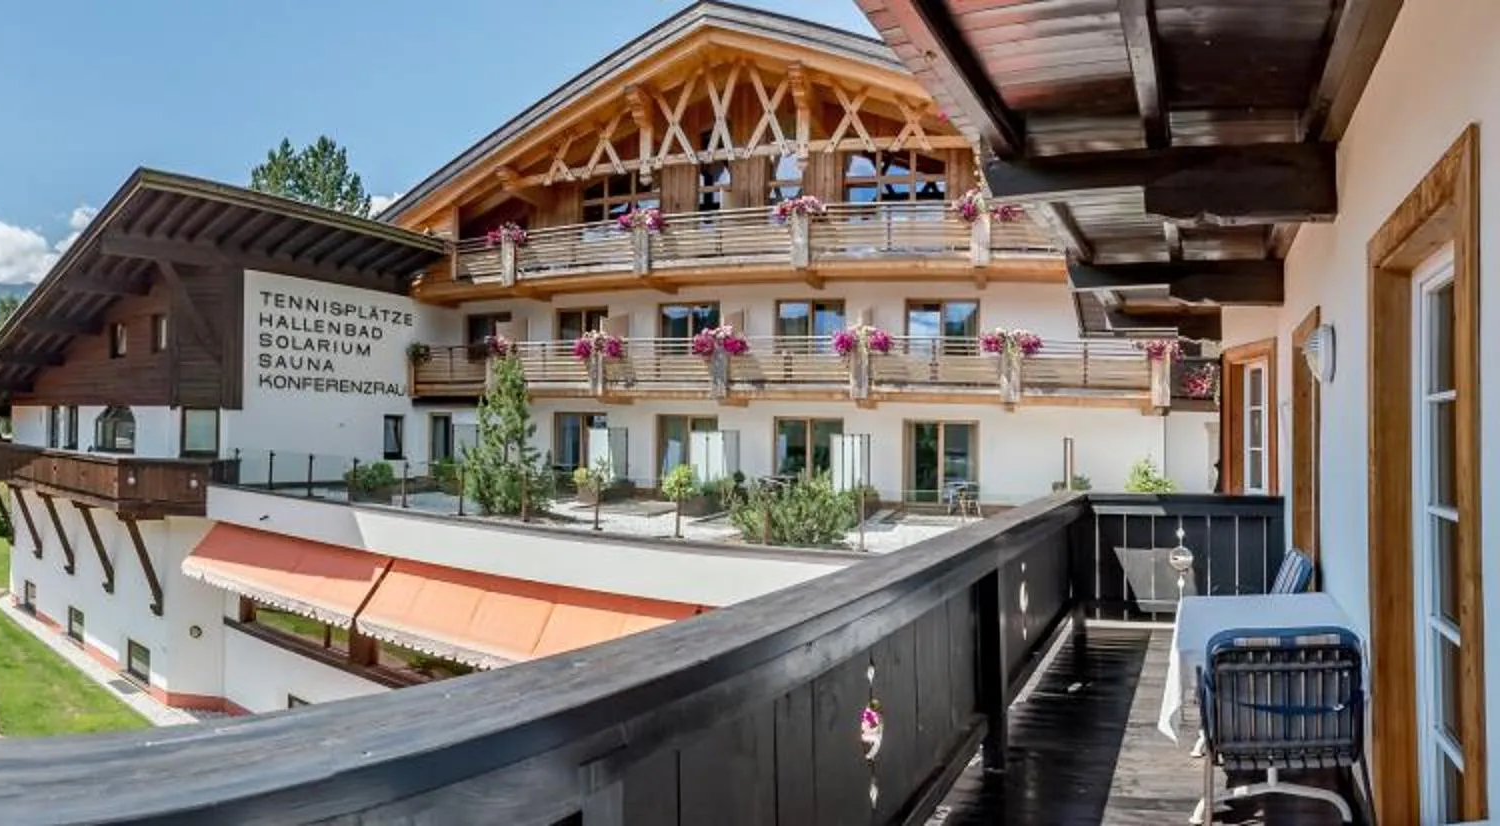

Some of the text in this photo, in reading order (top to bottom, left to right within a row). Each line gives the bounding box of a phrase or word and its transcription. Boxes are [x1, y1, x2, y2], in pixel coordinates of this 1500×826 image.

[260, 292, 413, 326] TENNISPLÄTZE
[259, 312, 383, 340] HALLENBAD
[259, 333, 371, 357] SOLARIUM
[259, 353, 334, 373] SAUNA
[259, 374, 406, 397] KONFERENZRAU
